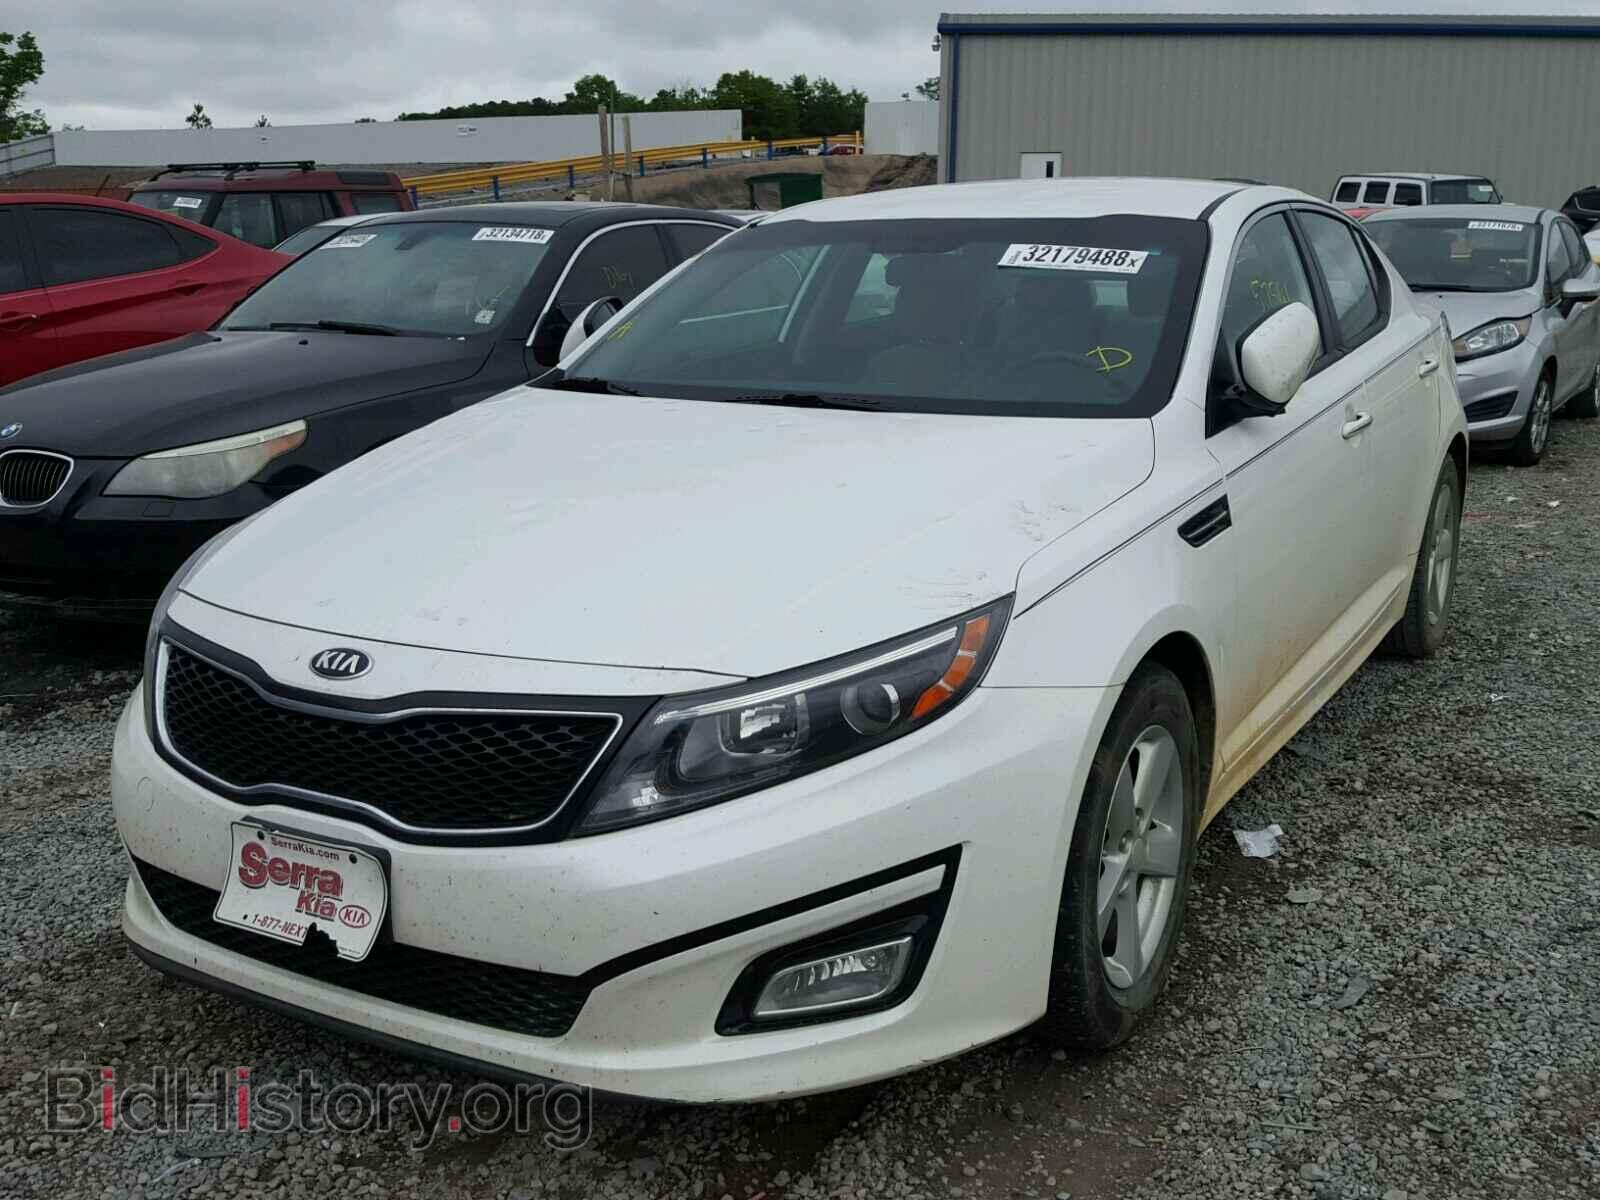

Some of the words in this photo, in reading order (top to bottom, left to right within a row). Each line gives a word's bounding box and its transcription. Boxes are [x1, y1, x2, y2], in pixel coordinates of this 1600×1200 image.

[1086, 346, 1132, 372] D
[315, 650, 360, 673] KIA
[271, 837, 340, 861] SerraKia.com
[238, 841, 343, 897] Serra
[295, 888, 337, 922] Kia
[343, 910, 366, 926] KIA
